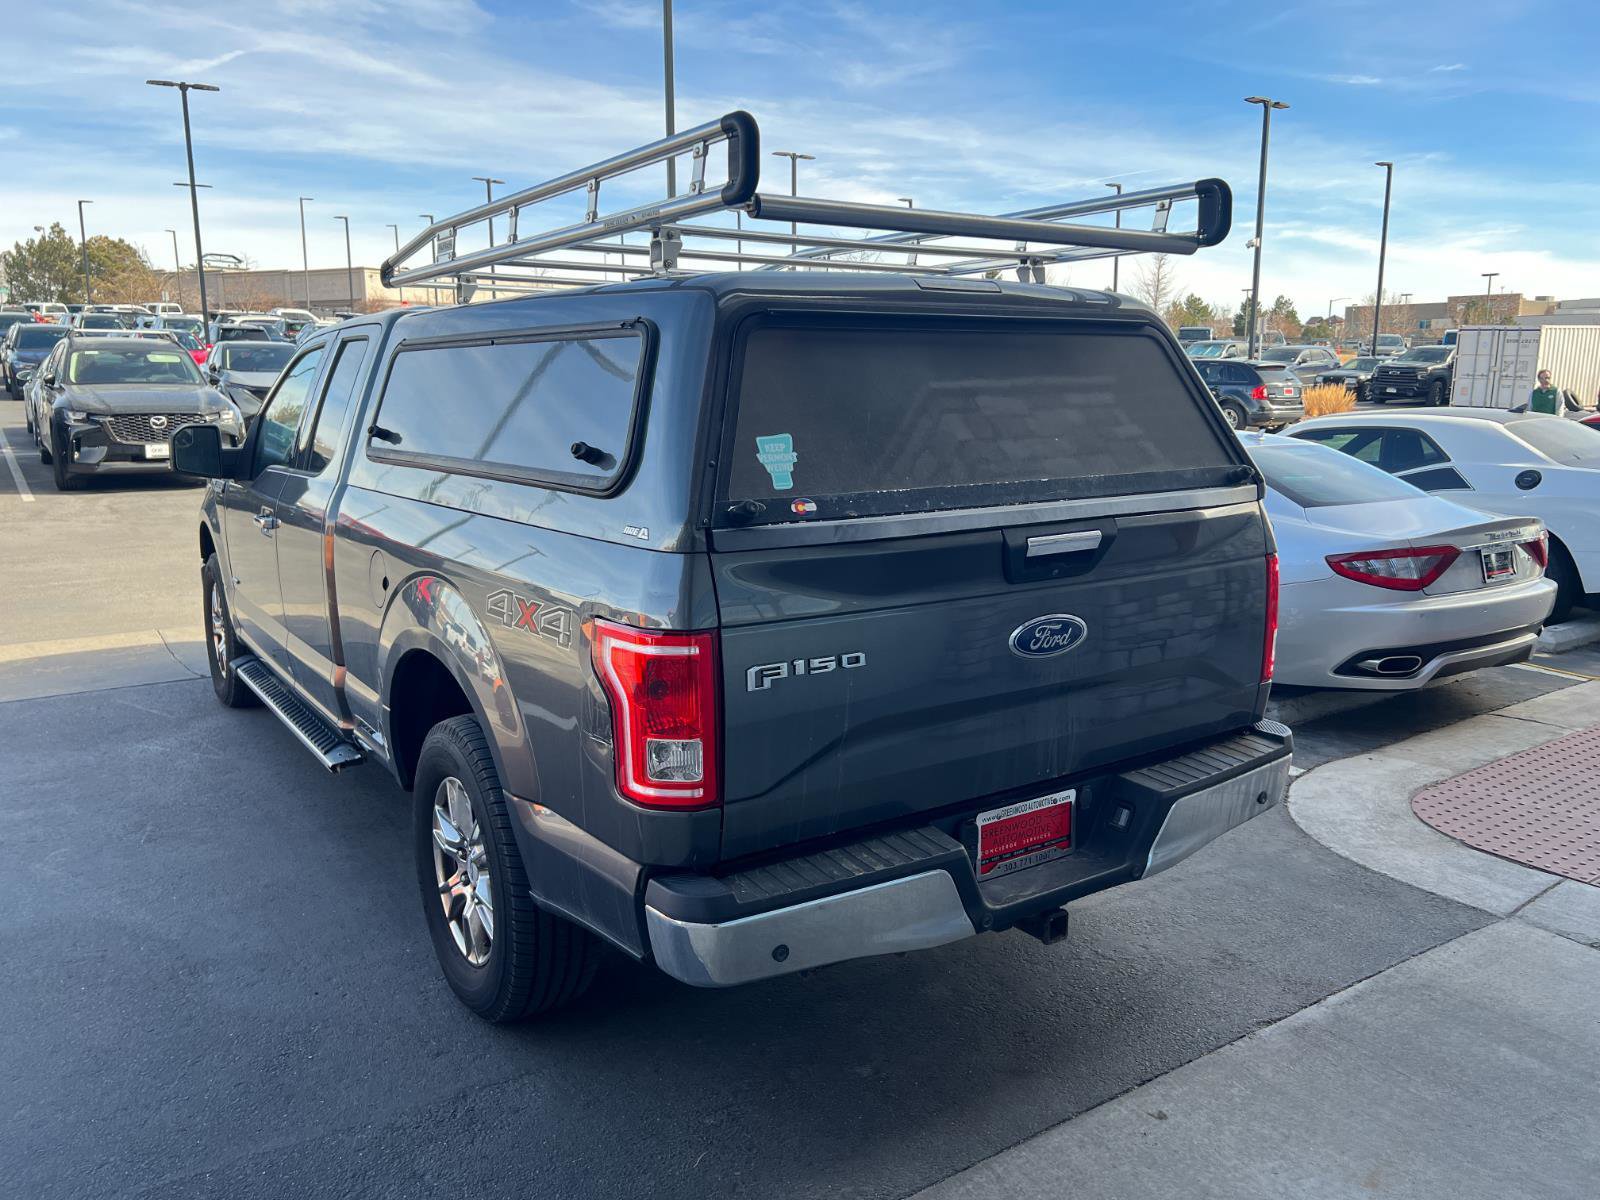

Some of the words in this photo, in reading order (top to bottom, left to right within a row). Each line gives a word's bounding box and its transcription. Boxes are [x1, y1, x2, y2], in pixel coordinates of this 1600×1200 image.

[1030, 624, 1072, 651] Ford
[982, 815, 1042, 838] GREENWOOD
[992, 823, 1051, 845] AUTOMOTIVE
